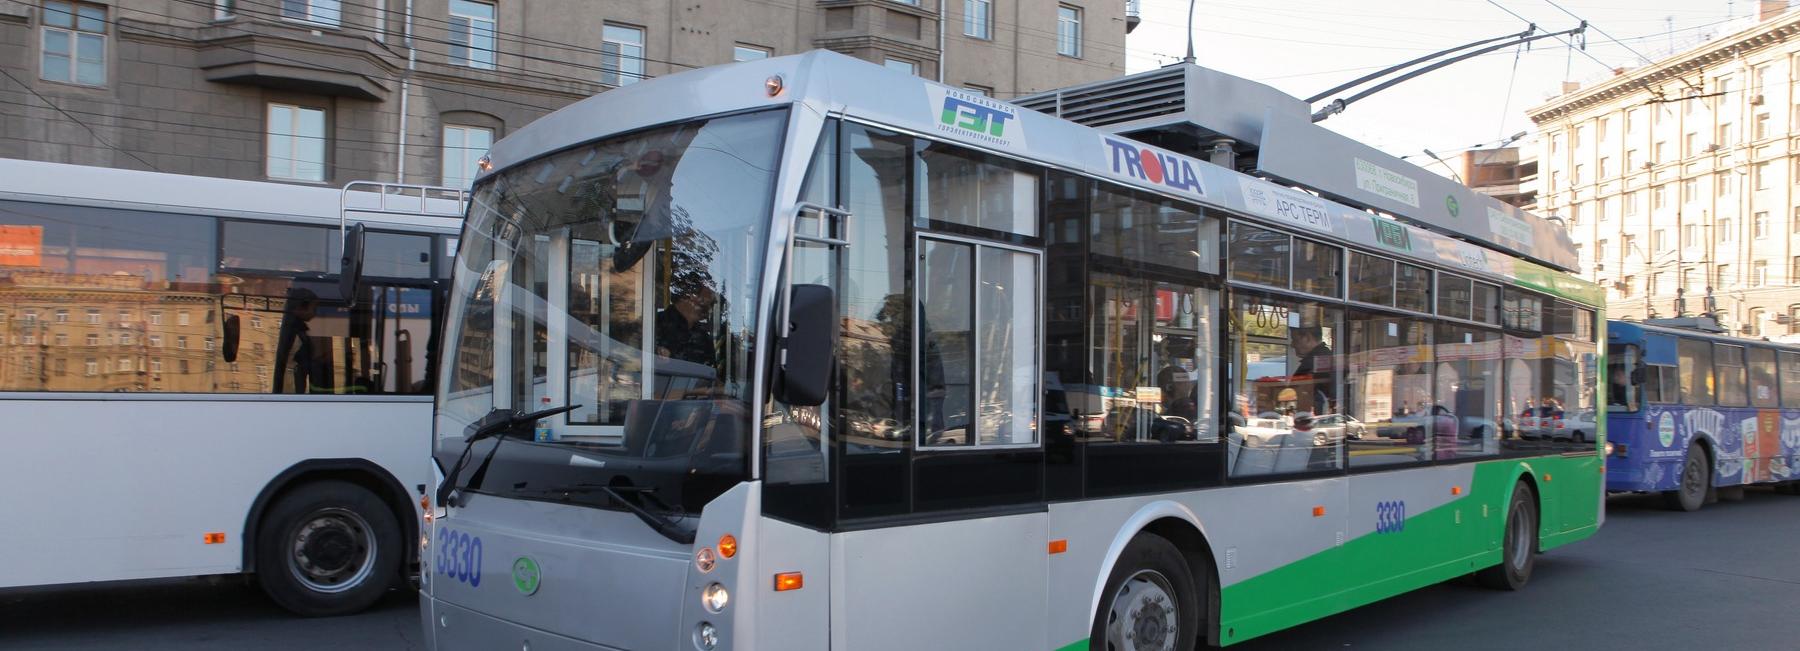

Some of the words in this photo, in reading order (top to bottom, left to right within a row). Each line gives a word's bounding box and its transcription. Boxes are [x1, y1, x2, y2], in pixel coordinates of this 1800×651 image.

[945, 89, 1015, 114] НОВОСИБИРСК
[1105, 138, 1204, 195] TROLZA
[1276, 199, 1299, 220] АРС
[1298, 205, 1330, 230] ТЕРМ
[1376, 500, 1405, 534] 3330
[437, 526, 483, 588] 3330
